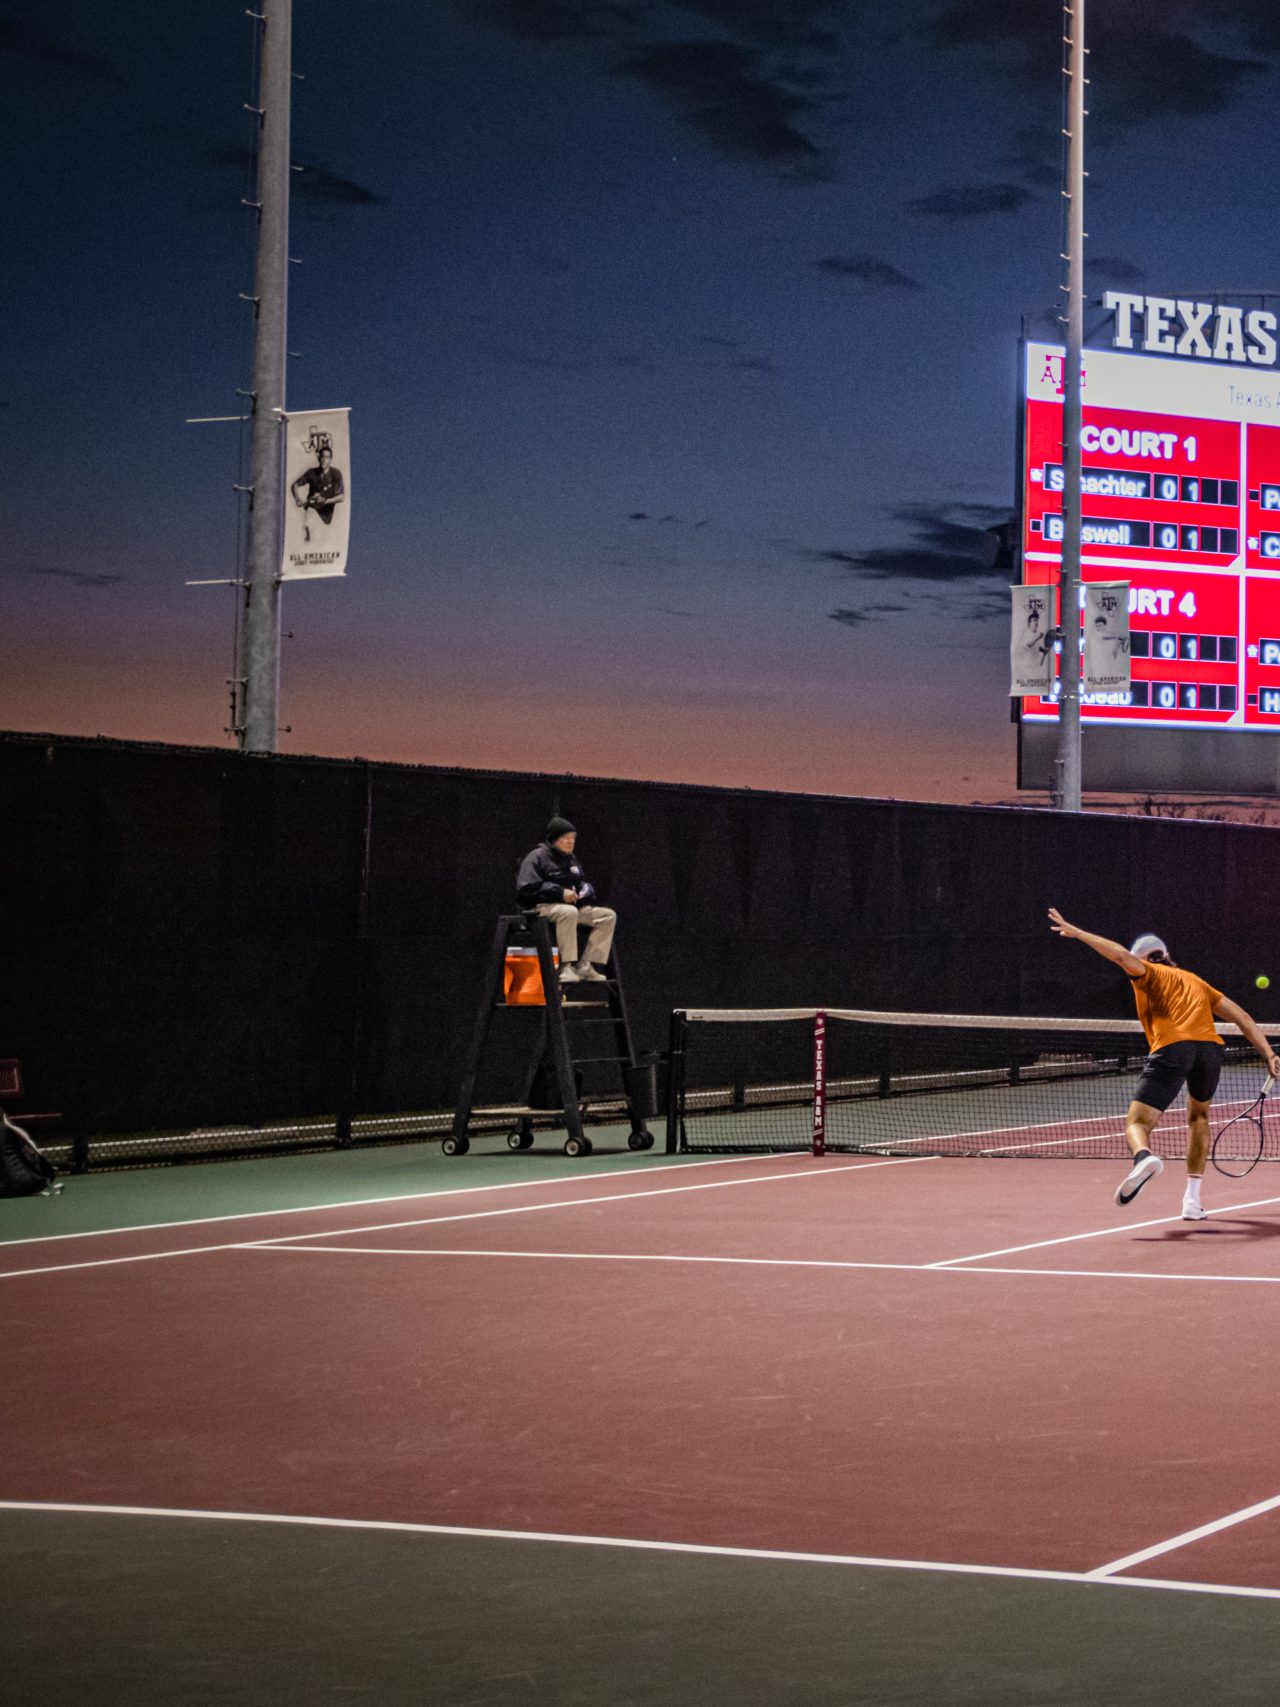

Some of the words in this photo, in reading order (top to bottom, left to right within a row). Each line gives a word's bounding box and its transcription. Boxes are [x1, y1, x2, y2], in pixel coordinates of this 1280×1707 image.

[1103, 290, 1277, 365] TEXAS
[1228, 386, 1272, 409] Texas
[1080, 425, 1178, 459] COURT
[1183, 436, 1197, 462] 1
[1163, 479, 1176, 500] 0
[1189, 481, 1198, 501] 1
[1049, 519, 1131, 546] Bswell
[1162, 528, 1176, 549] 0
[1188, 530, 1198, 550] 1
[1179, 591, 1197, 618] 4
[1161, 638, 1175, 658] 0
[1187, 639, 1197, 659] 1
[1160, 687, 1174, 707] 0
[1187, 688, 1197, 708] 1
[815, 1040, 823, 1091] TEXAS
